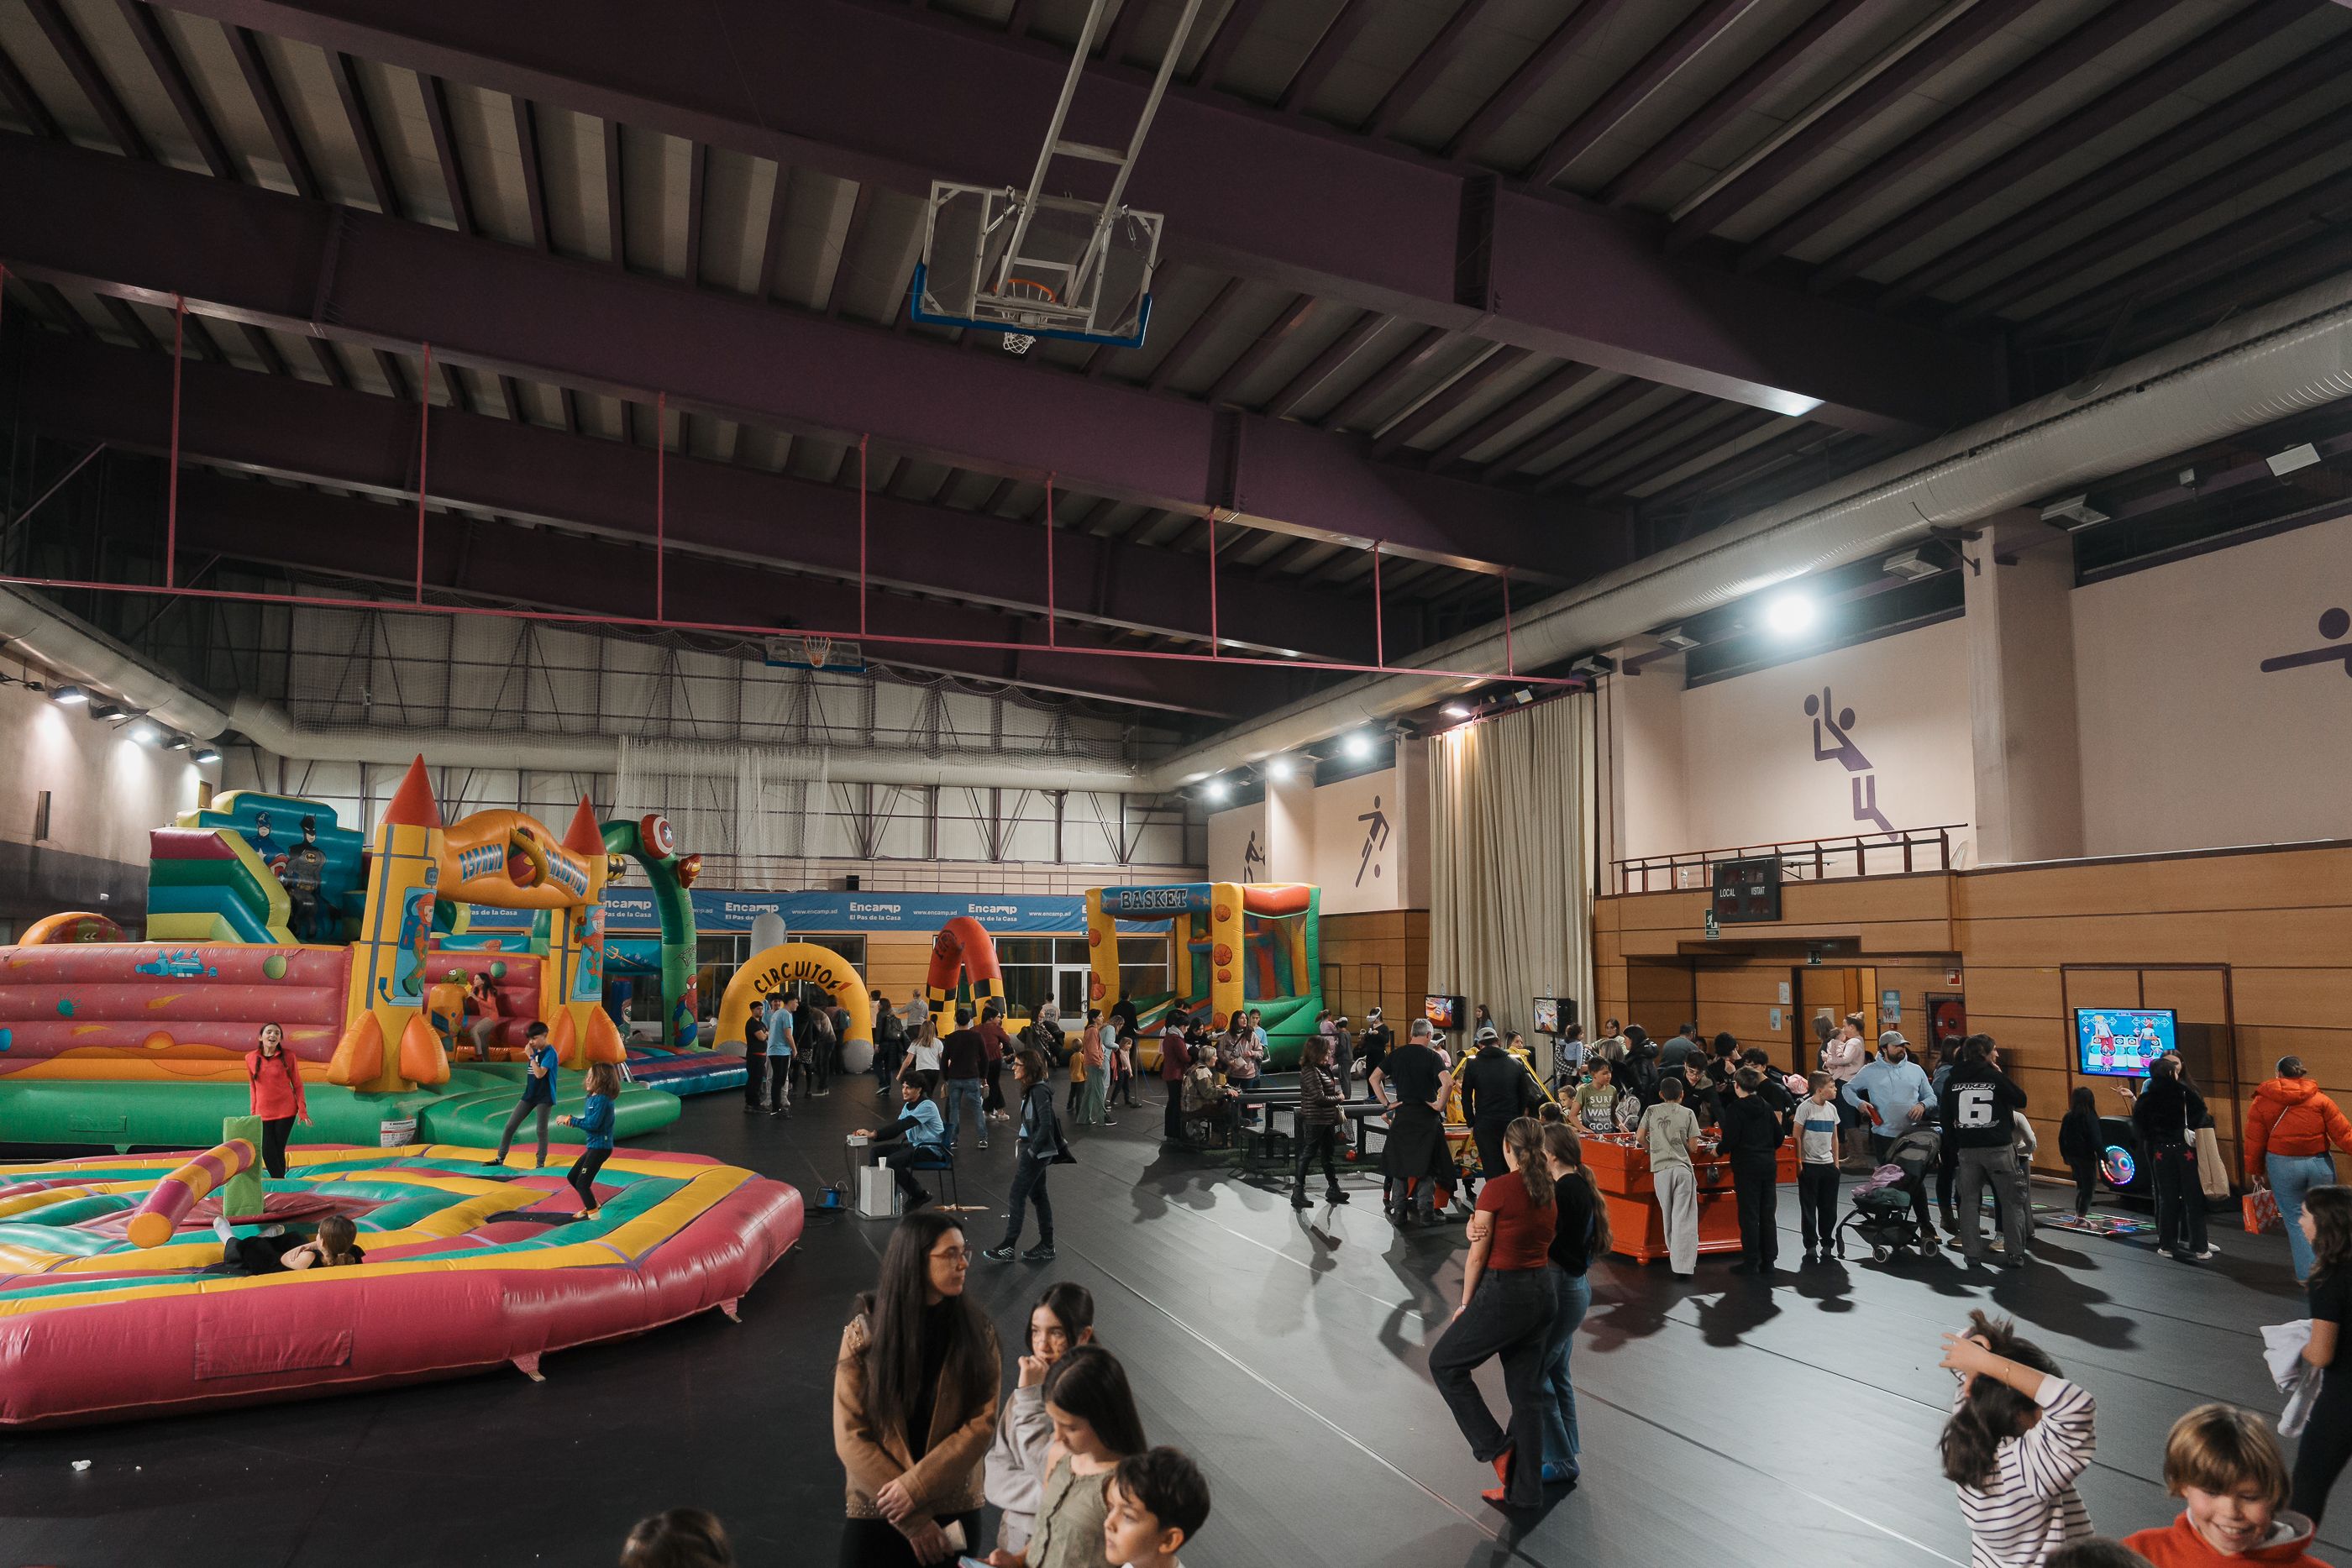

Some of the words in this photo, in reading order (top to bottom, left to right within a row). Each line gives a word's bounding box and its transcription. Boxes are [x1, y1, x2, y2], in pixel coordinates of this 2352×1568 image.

[1719, 888, 1735, 898] LOCAL
[605, 899, 652, 910] ncamp
[1121, 889, 1187, 910] BASKET
[725, 902, 780, 914] Encamp
[849, 902, 901, 914] Encamp
[968, 903, 1018, 915] Encamp
[753, 961, 832, 994] CIRCUITO
[1951, 1083, 1996, 1091] BAKER
[1589, 1095, 1613, 1104] SURF
[1958, 1090, 1993, 1125] 6
